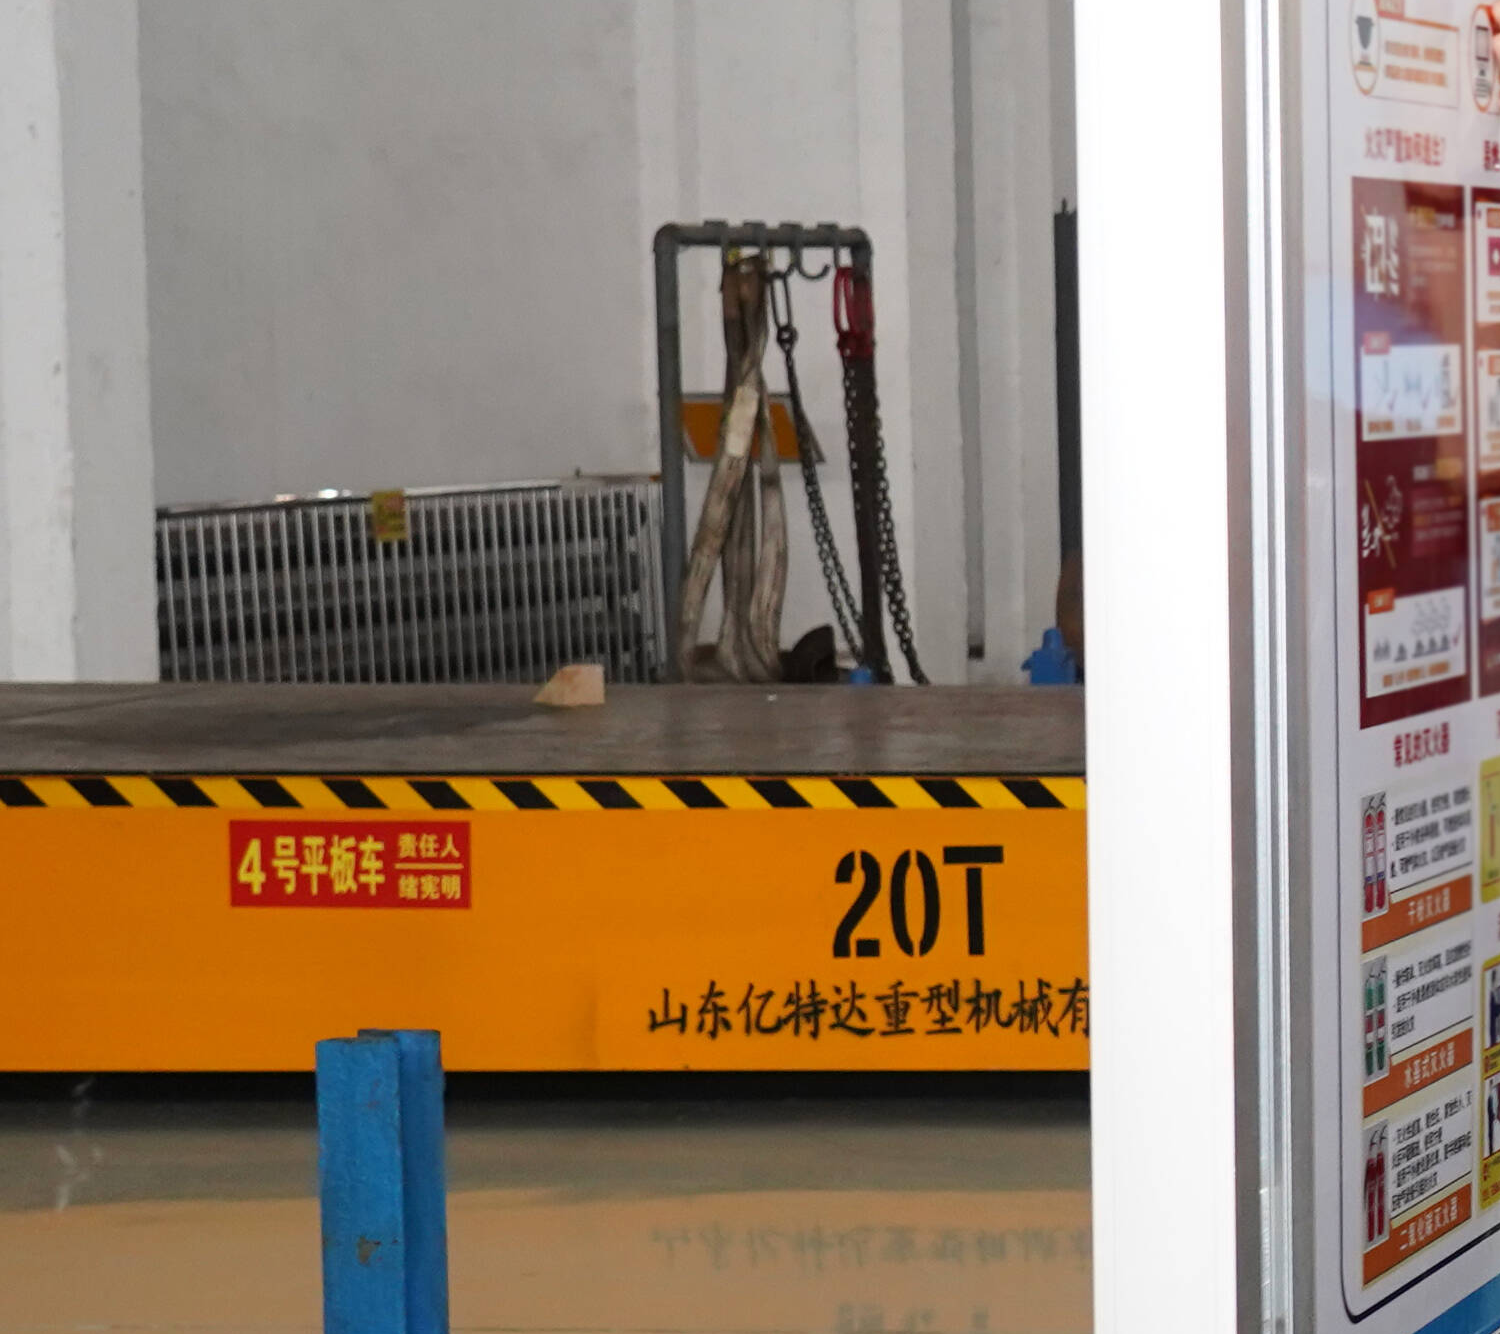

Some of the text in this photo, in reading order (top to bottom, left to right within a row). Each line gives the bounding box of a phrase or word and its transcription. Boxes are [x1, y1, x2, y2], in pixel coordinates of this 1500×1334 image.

[238, 835, 386, 897] 4号平板车
[398, 833, 461, 859] 责任人
[833, 845, 1004, 958] 20T
[648, 977, 1090, 1041] 山东亿特达重型机械有
